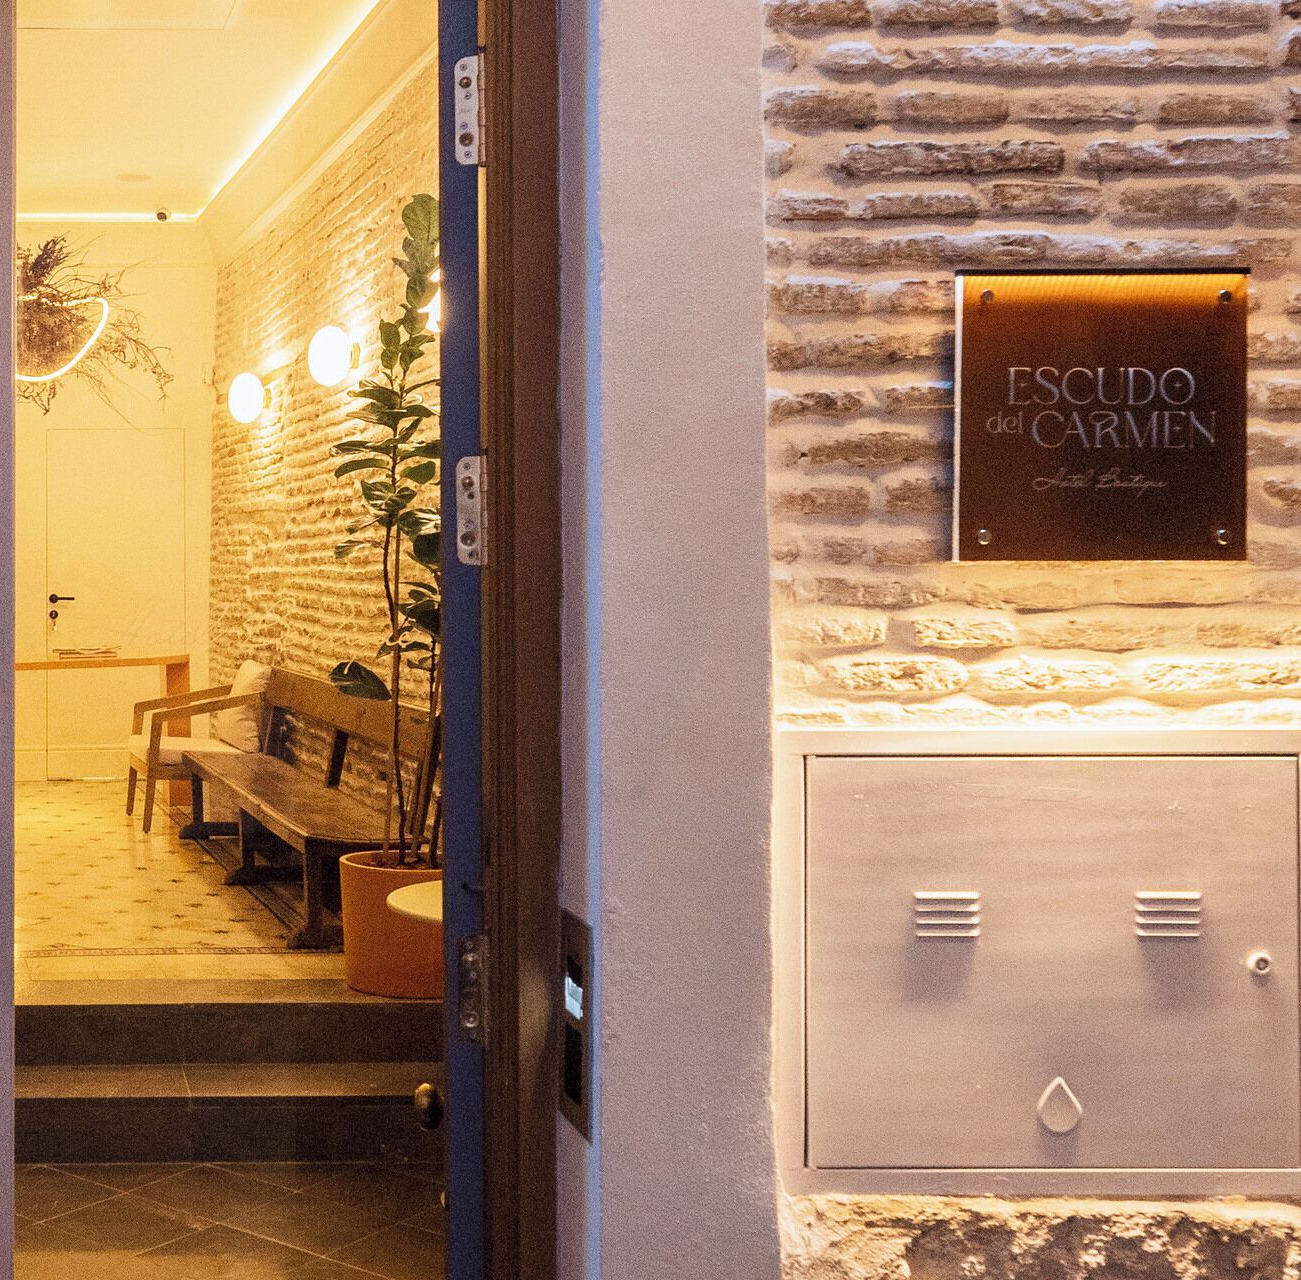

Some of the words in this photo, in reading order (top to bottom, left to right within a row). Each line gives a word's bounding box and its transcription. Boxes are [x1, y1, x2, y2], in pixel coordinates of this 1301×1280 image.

[1008, 367, 1196, 405] ESCUDO
[986, 411, 1024, 434] del
[1032, 410, 1217, 448] CARMEN
